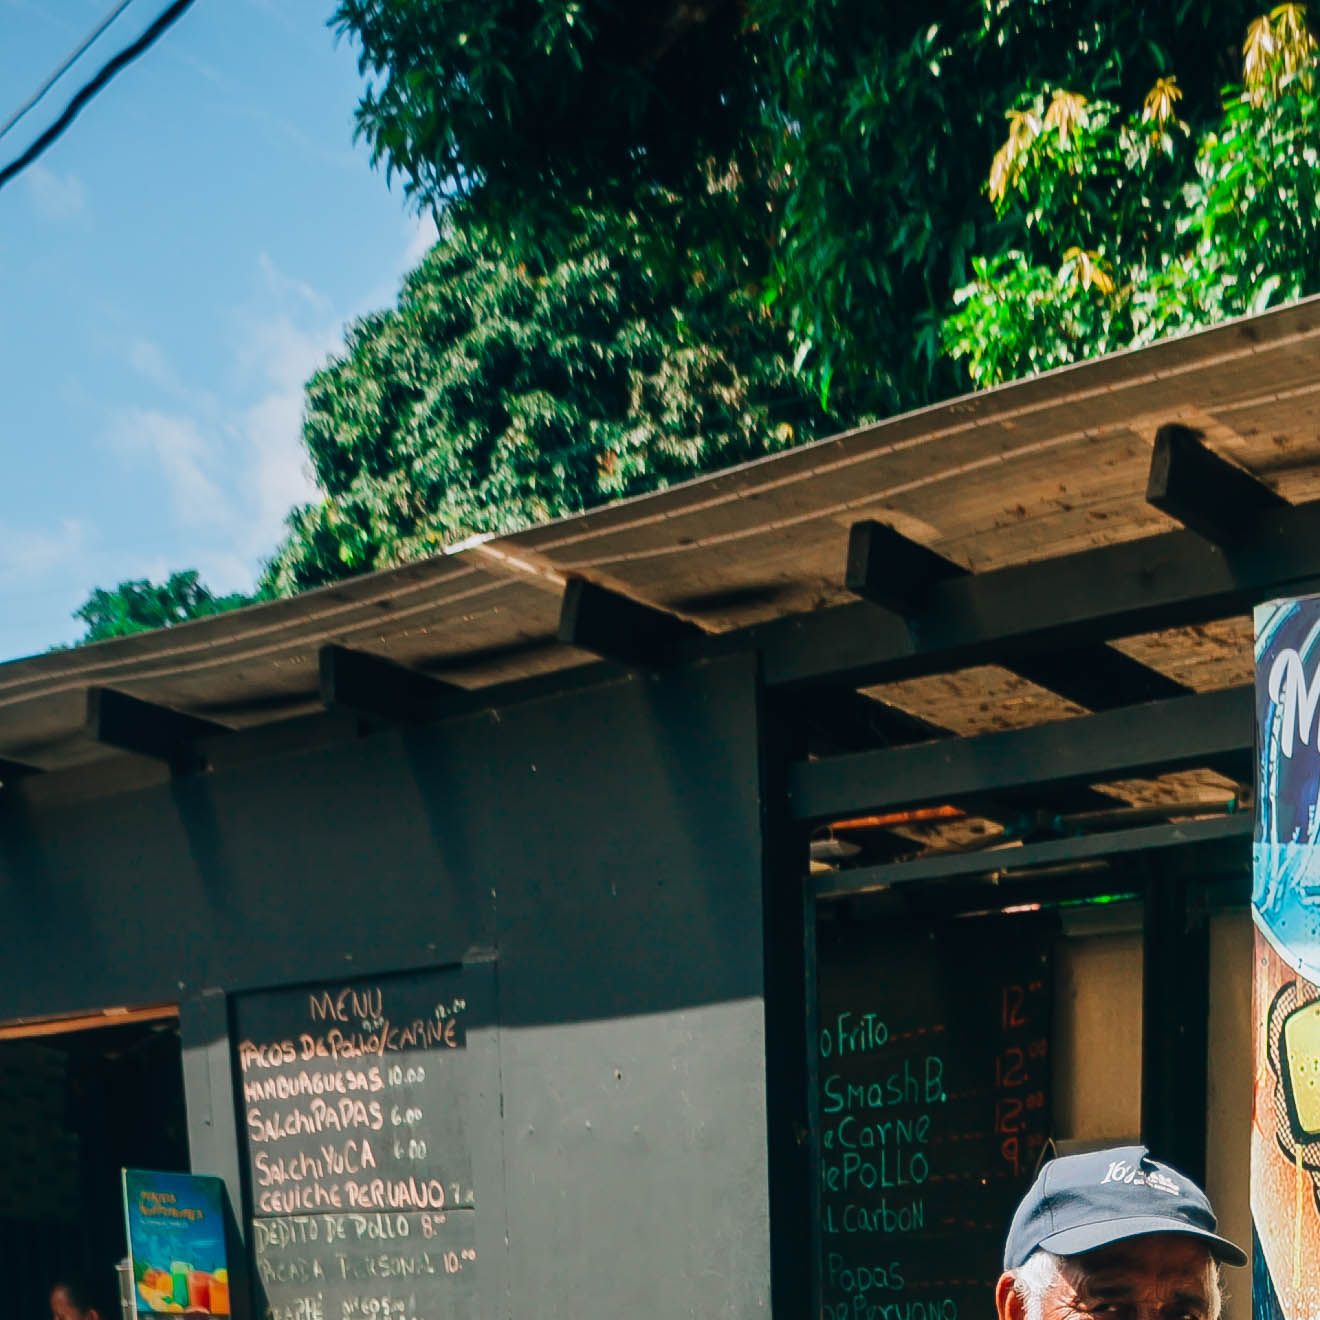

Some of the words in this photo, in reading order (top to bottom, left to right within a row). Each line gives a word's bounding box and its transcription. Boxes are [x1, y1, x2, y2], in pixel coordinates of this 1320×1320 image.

[310, 987, 382, 1022] MENU
[240, 1039, 296, 1072] TACOS
[244, 1066, 384, 1103] HAMBURGUESAS
[345, 1177, 445, 1209] PERUANO
[349, 1213, 409, 1239] POLLO
